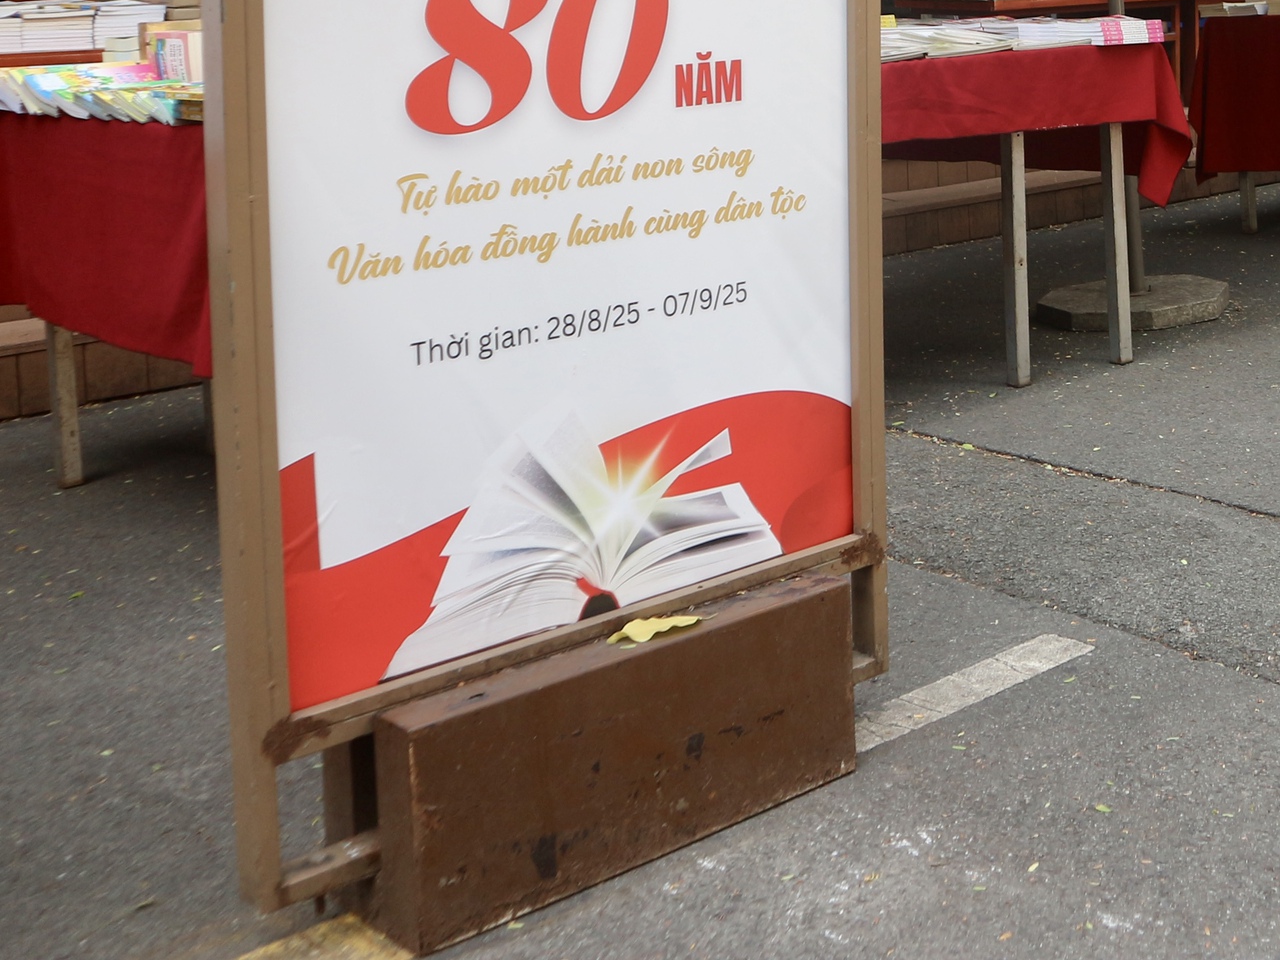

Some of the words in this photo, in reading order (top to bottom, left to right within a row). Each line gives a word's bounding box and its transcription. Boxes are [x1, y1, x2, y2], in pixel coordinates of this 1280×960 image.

[674, 51, 742, 108] NĂM
[396, 172, 438, 217] Tự
[445, 170, 500, 207] hào
[510, 157, 574, 200] một
[577, 152, 628, 189] dải
[631, 159, 685, 182] non
[692, 146, 755, 184] sông
[327, 243, 404, 286] Văn
[412, 235, 473, 272] hóa
[480, 223, 560, 265] đồng
[566, 205, 638, 248] hành
[643, 204, 708, 239] cùng
[714, 191, 765, 225] dân
[770, 185, 807, 221] tộc
[410, 330, 471, 367] Thời
[478, 322, 540, 361] gian:
[546, 300, 641, 342] 28/8/25
[662, 280, 748, 317] 07/9/25
